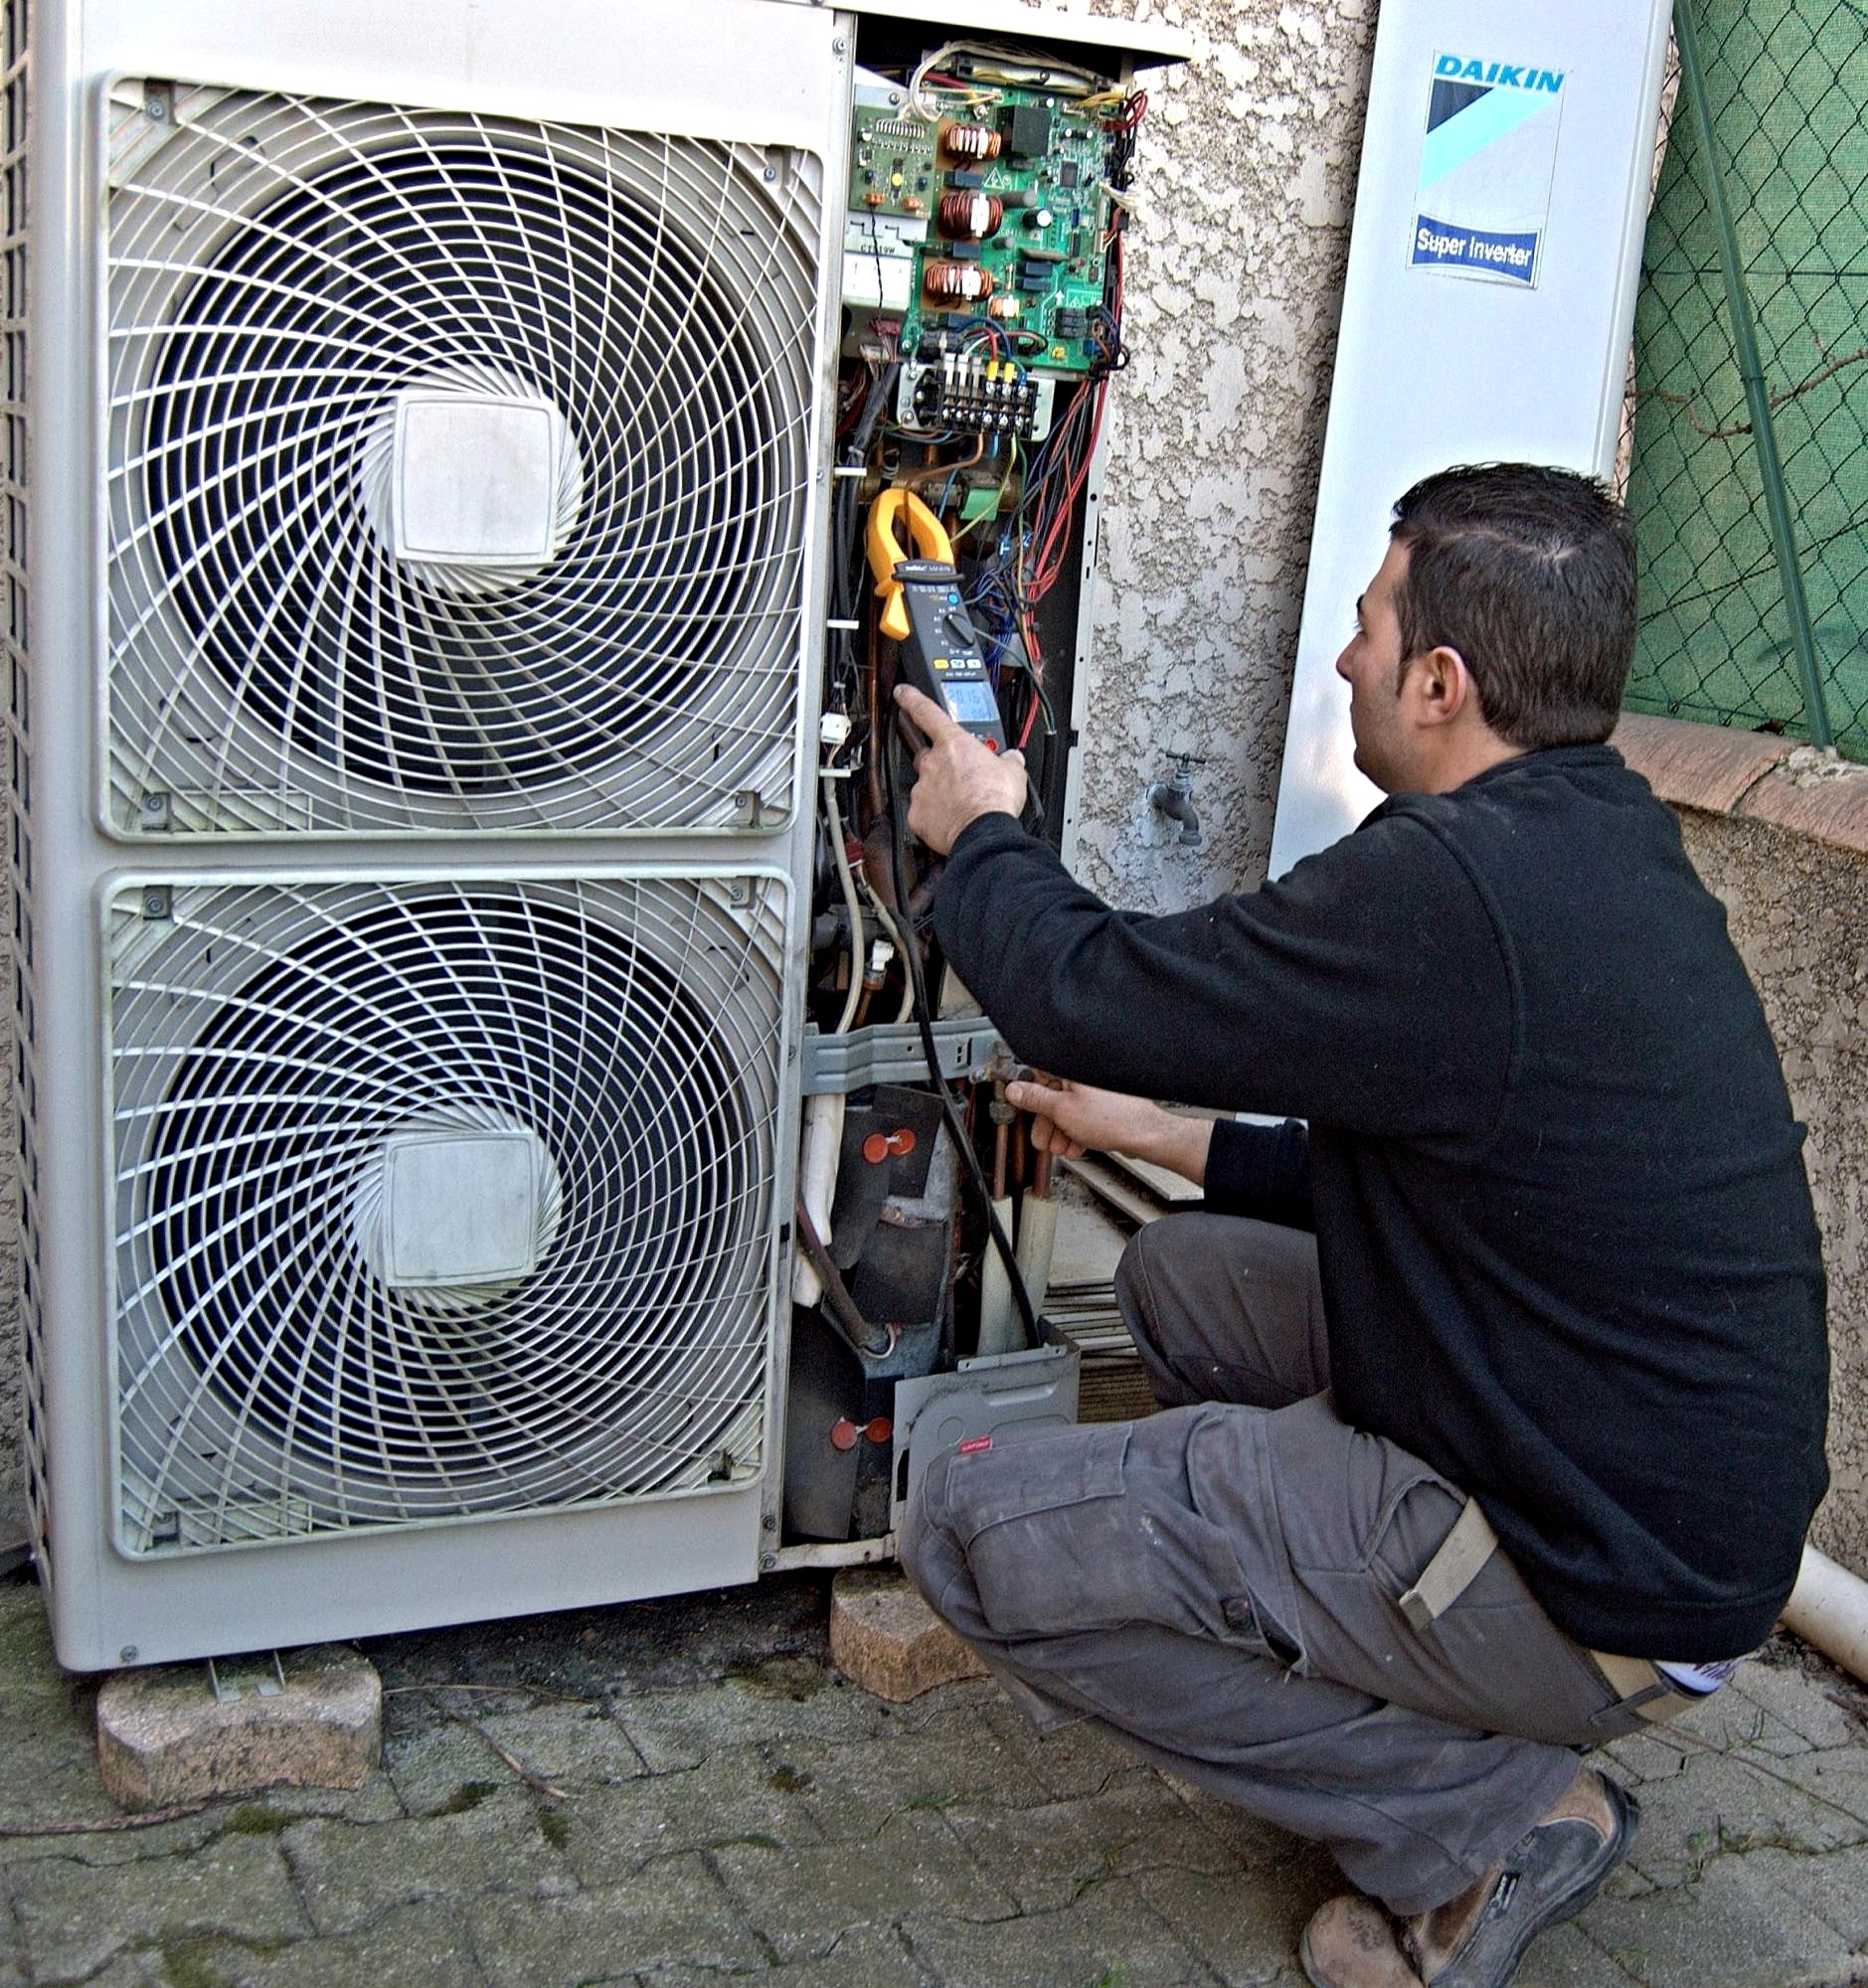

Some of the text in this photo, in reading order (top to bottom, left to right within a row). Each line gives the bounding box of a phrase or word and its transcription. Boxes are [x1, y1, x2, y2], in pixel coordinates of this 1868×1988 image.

[1435, 55, 1565, 93] DAIKIN
[1417, 228, 1533, 266] Super Inverter
